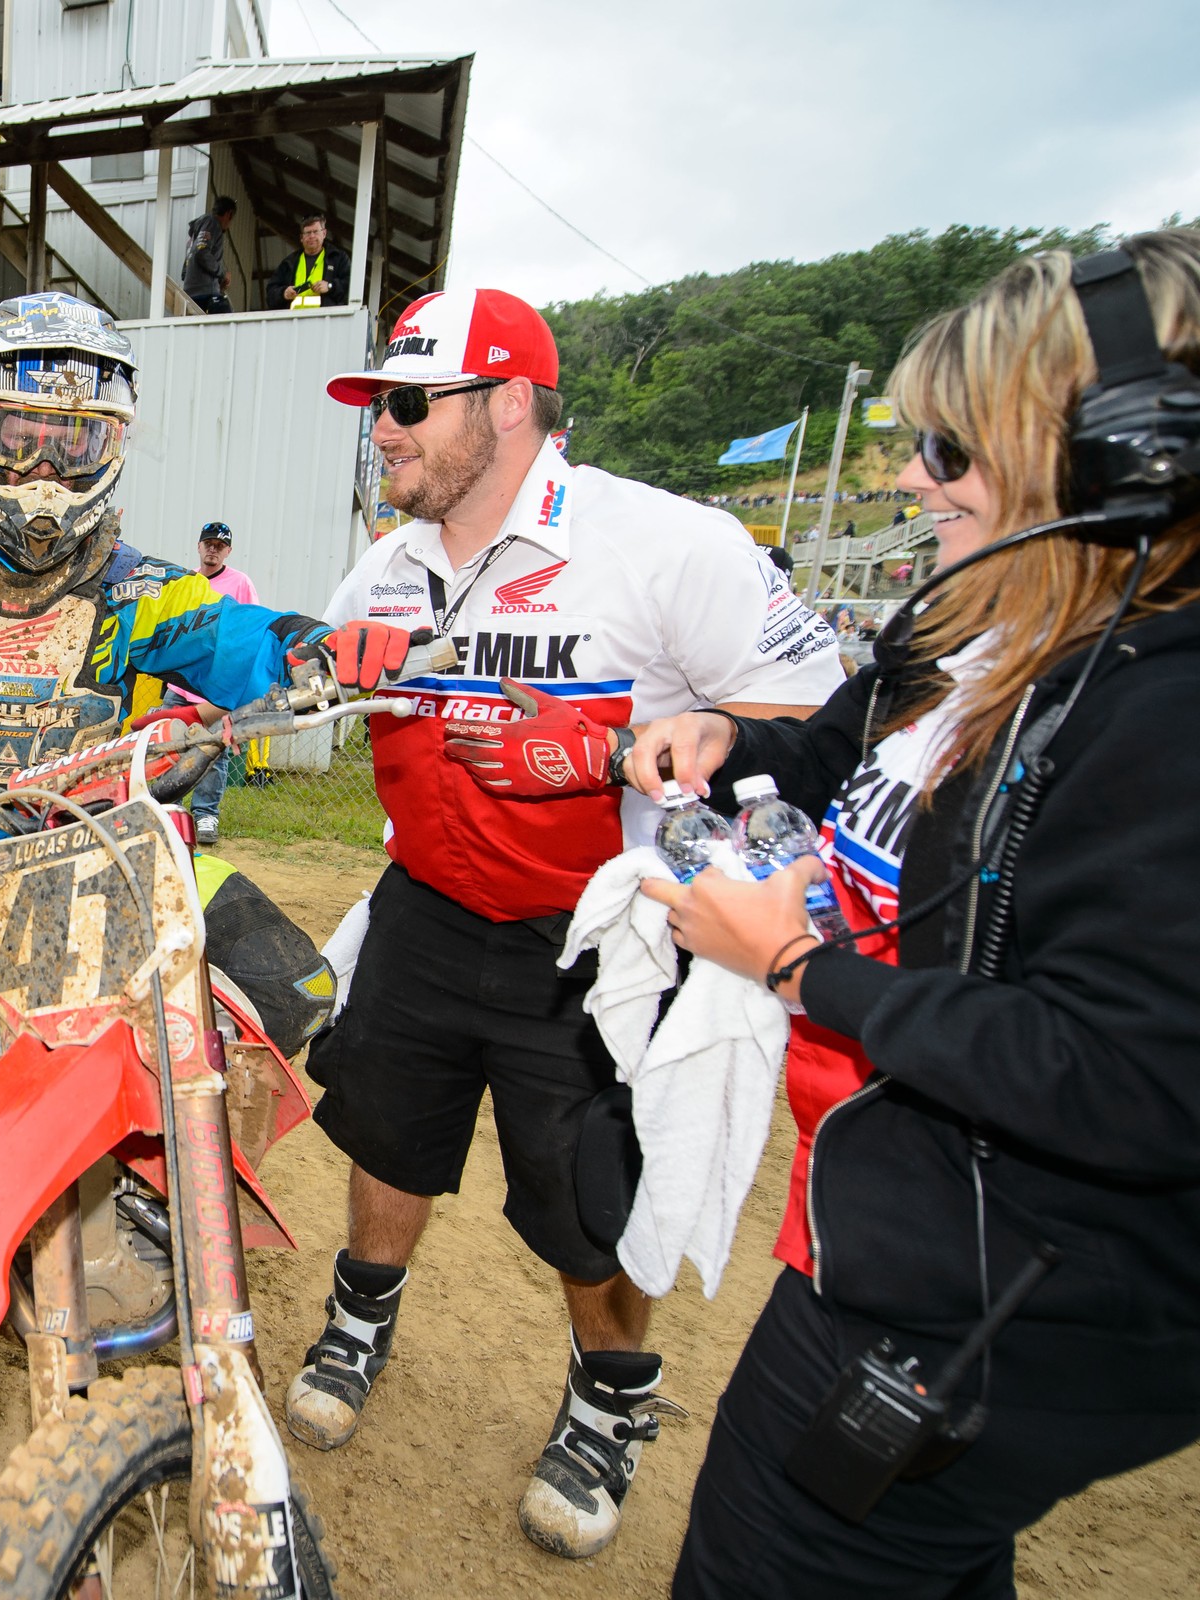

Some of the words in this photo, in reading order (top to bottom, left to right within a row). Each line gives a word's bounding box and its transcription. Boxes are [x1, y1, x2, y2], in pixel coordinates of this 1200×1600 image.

[401, 337, 438, 356] MILK
[113, 580, 162, 602] WPS
[368, 605, 391, 613] Honda
[392, 605, 422, 614] Racing
[491, 603, 559, 615] HONDA
[758, 618, 801, 654] HINSON
[25, 704, 76, 728] MILK
[15, 833, 68, 865] LUCAS
[186, 1118, 239, 1300] SHOWA
[227, 1316, 253, 1340] AIR
